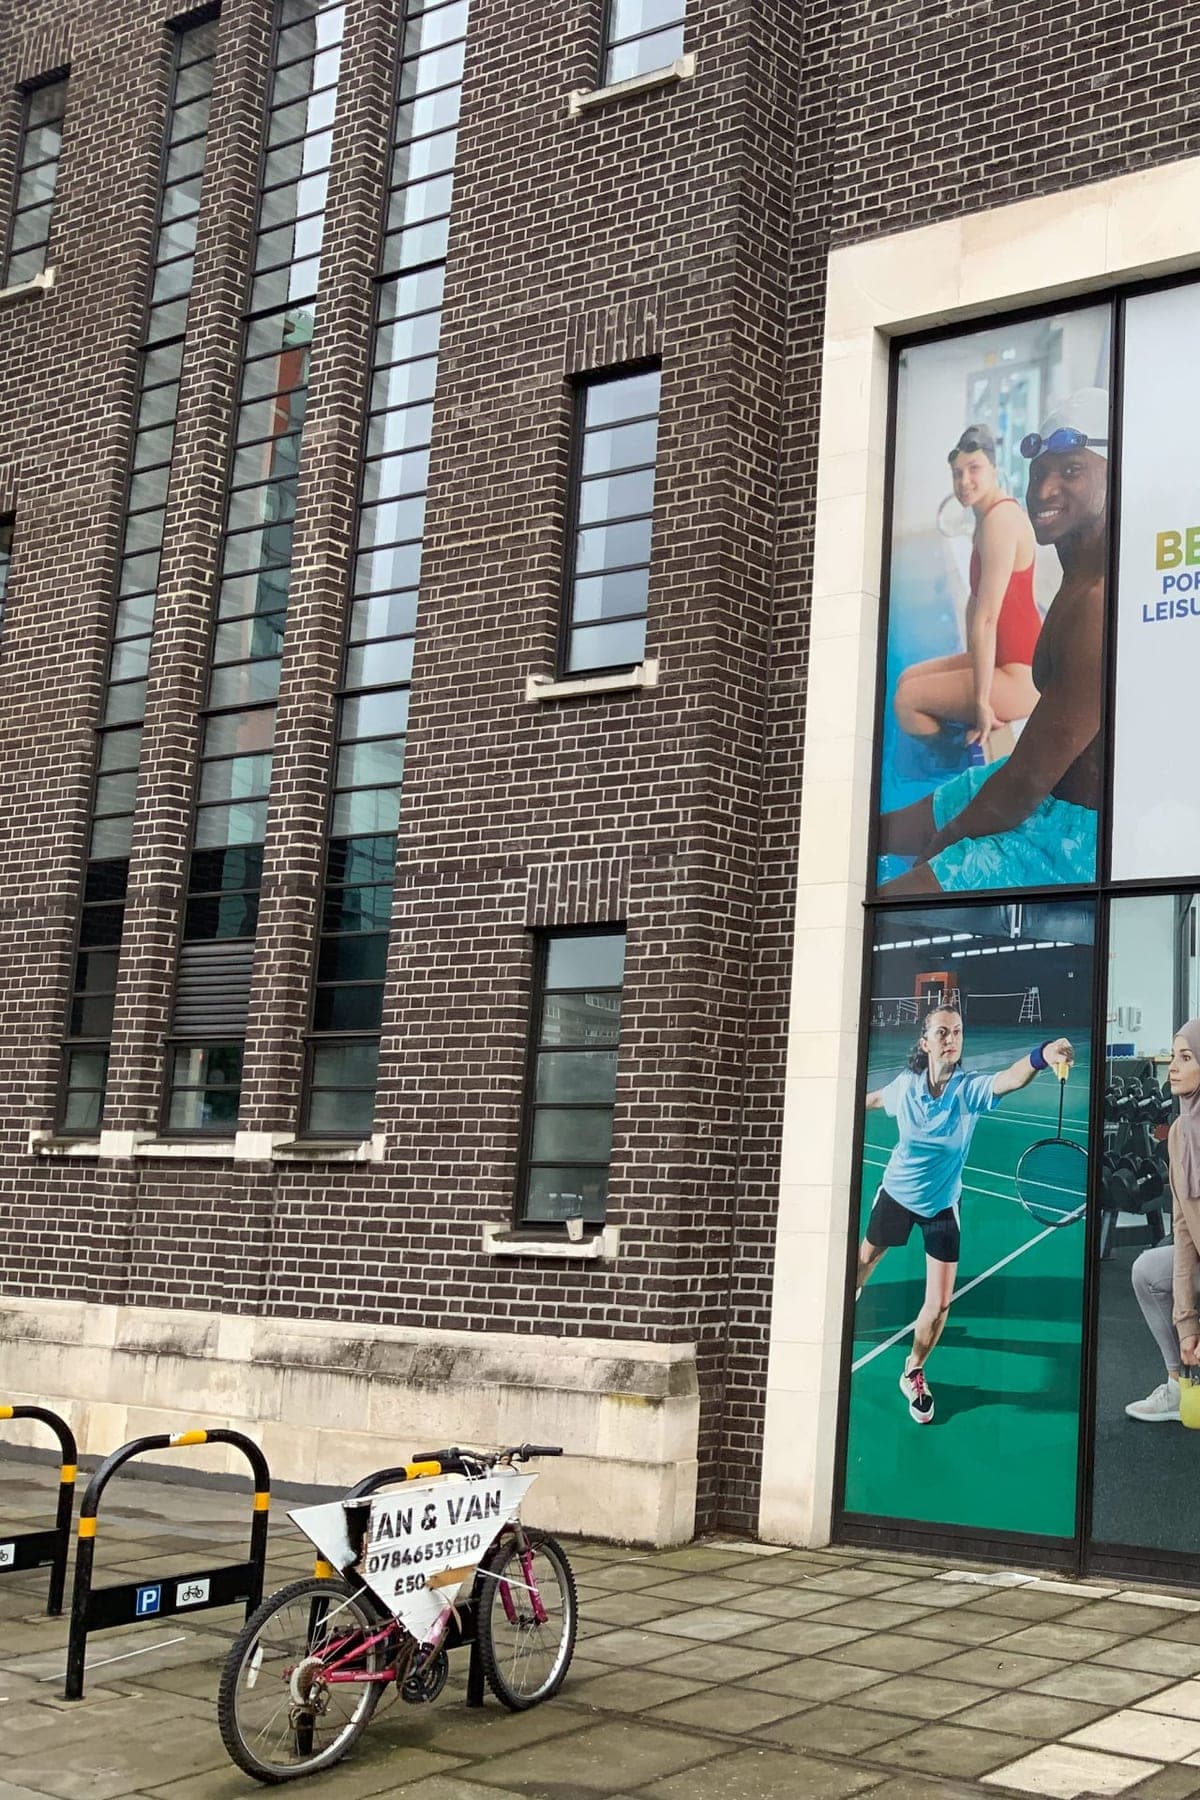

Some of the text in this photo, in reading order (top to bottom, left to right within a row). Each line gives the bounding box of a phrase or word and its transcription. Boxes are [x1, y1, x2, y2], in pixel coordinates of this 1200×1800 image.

[421, 1503, 437, 1531] &
[447, 1490, 502, 1525] VAN
[369, 1533, 481, 1573] 07846539110
[142, 1590, 157, 1612] P
